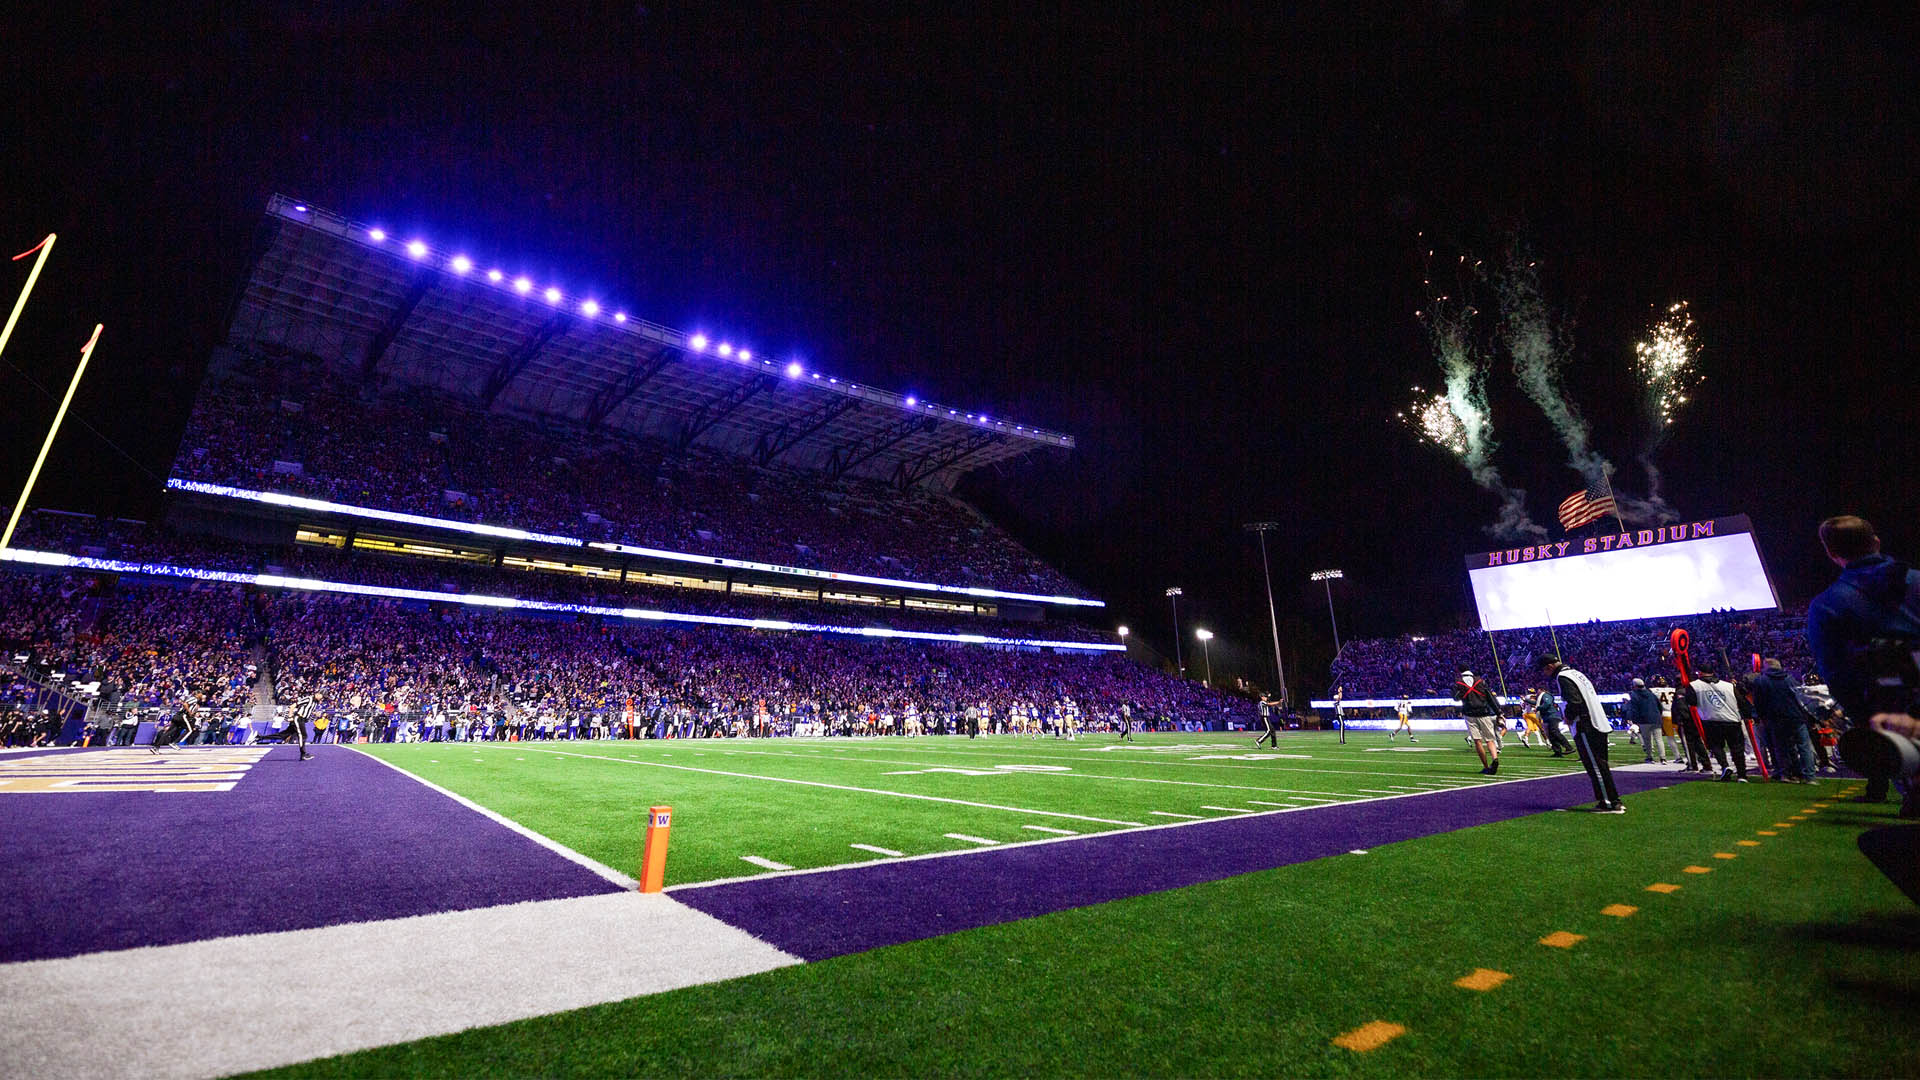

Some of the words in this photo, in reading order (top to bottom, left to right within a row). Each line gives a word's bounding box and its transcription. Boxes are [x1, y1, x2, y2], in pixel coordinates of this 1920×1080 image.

[1488, 541, 1570, 566] HUSKY
[1584, 520, 1715, 553] STADIUM
[658, 816, 669, 825] W
